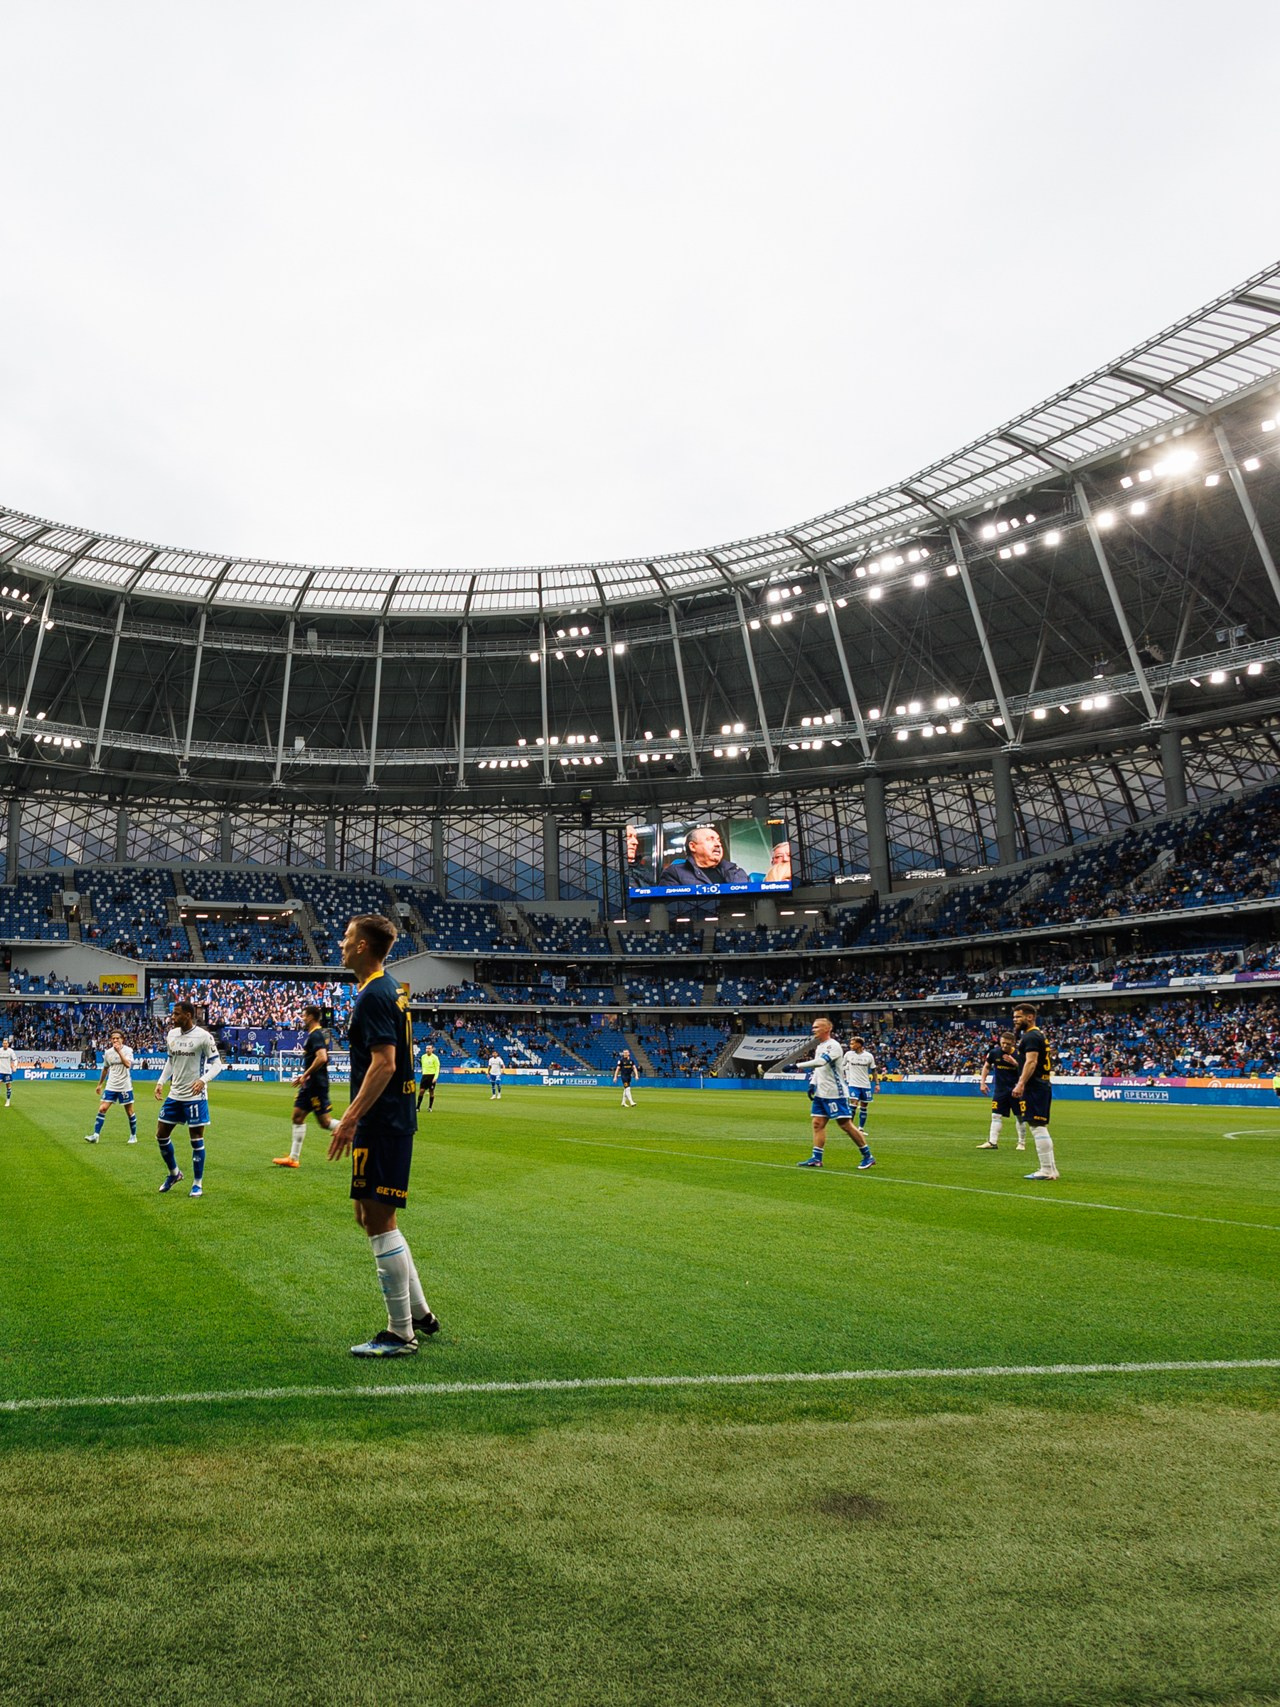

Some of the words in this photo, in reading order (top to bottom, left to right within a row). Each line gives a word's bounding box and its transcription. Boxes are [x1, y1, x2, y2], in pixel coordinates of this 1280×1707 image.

[24, 1069, 48, 1080] Брит
[543, 1076, 564, 1086] Брит
[1093, 1087, 1122, 1101] Брит
[1125, 1091, 1169, 1100] ПРЕМИУМ
[189, 1104, 199, 1118] 11
[828, 1102, 838, 1113] 10
[353, 1148, 368, 1176] 17
